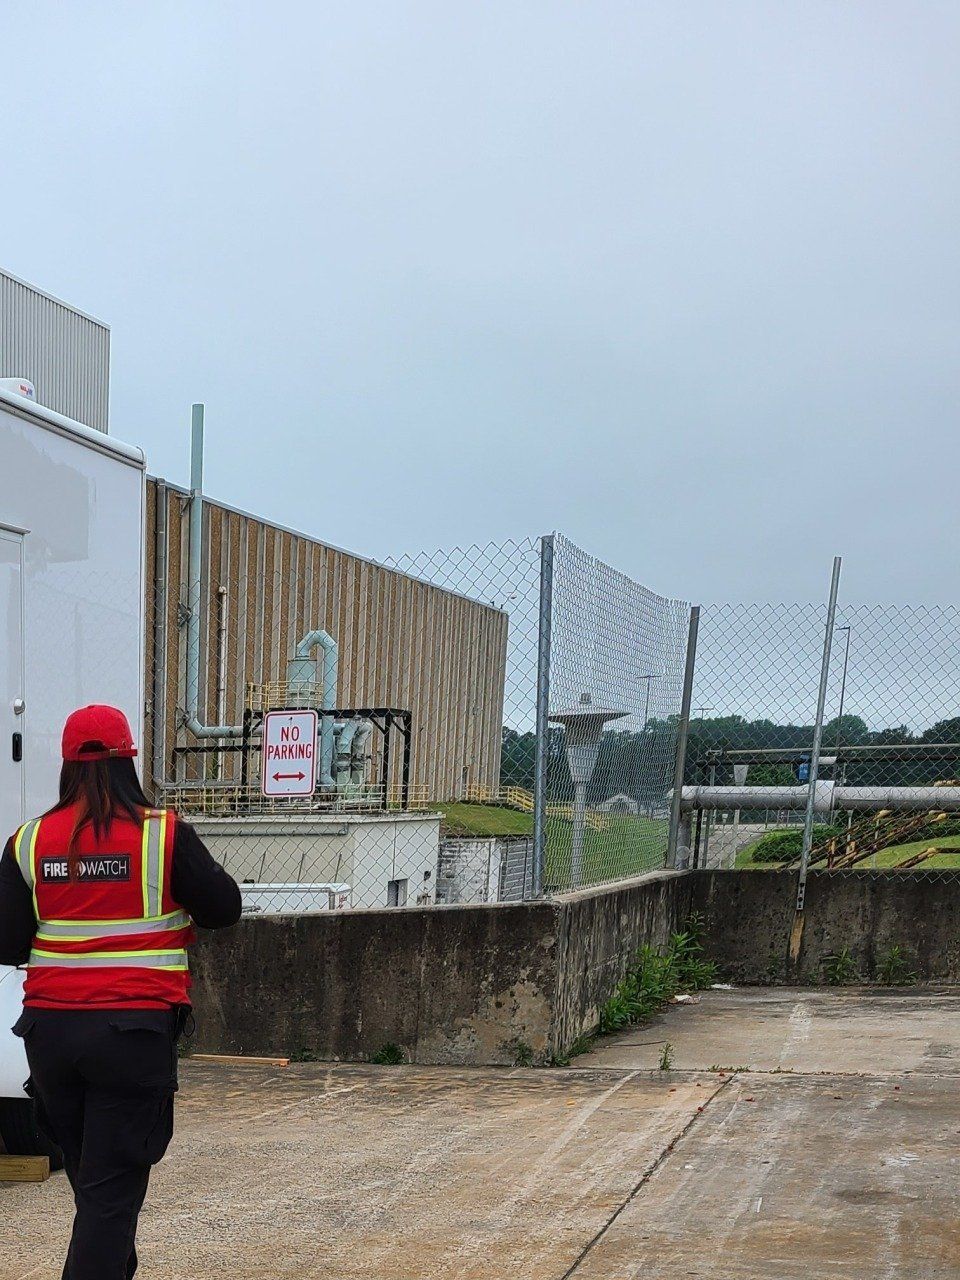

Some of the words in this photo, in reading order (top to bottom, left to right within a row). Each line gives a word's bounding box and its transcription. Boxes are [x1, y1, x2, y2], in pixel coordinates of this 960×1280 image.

[280, 726, 300, 742] NO
[267, 743, 313, 760] PARKING
[43, 862, 68, 877] FIRE
[85, 860, 127, 876] WATCH
